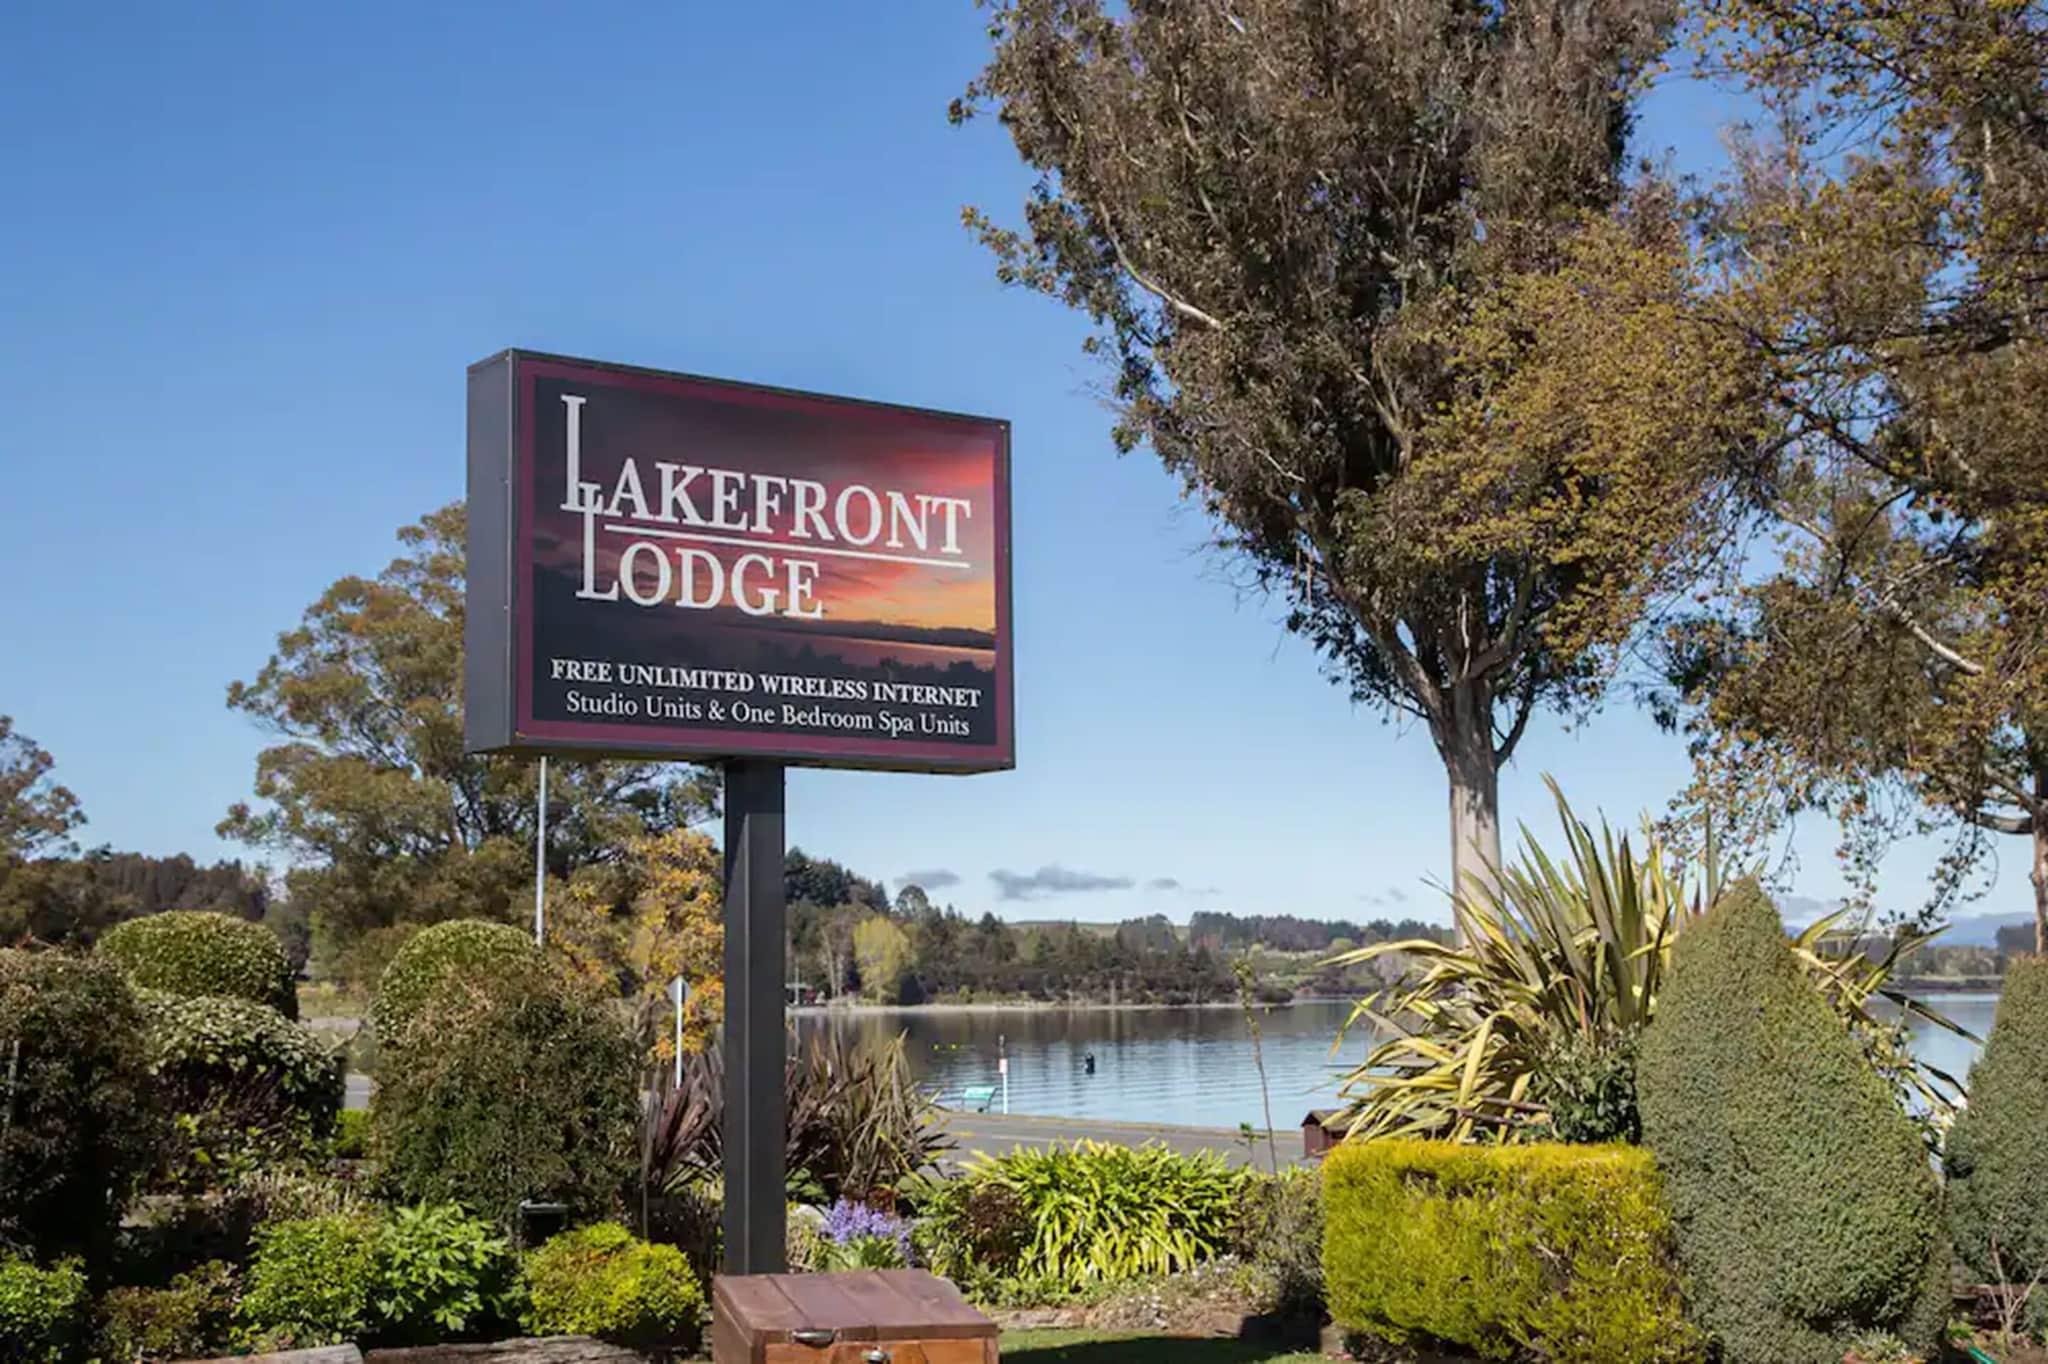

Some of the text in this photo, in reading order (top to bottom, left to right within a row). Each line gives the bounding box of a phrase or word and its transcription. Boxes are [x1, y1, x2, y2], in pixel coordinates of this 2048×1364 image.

[560, 394, 971, 555] LAKEFRONT
[576, 482, 823, 619] LODGE
[551, 658, 982, 709] FREE UNLIMITED WIRELESS INTERNET
[566, 691, 971, 738] Studio Units & One Bedroom Spa Units
